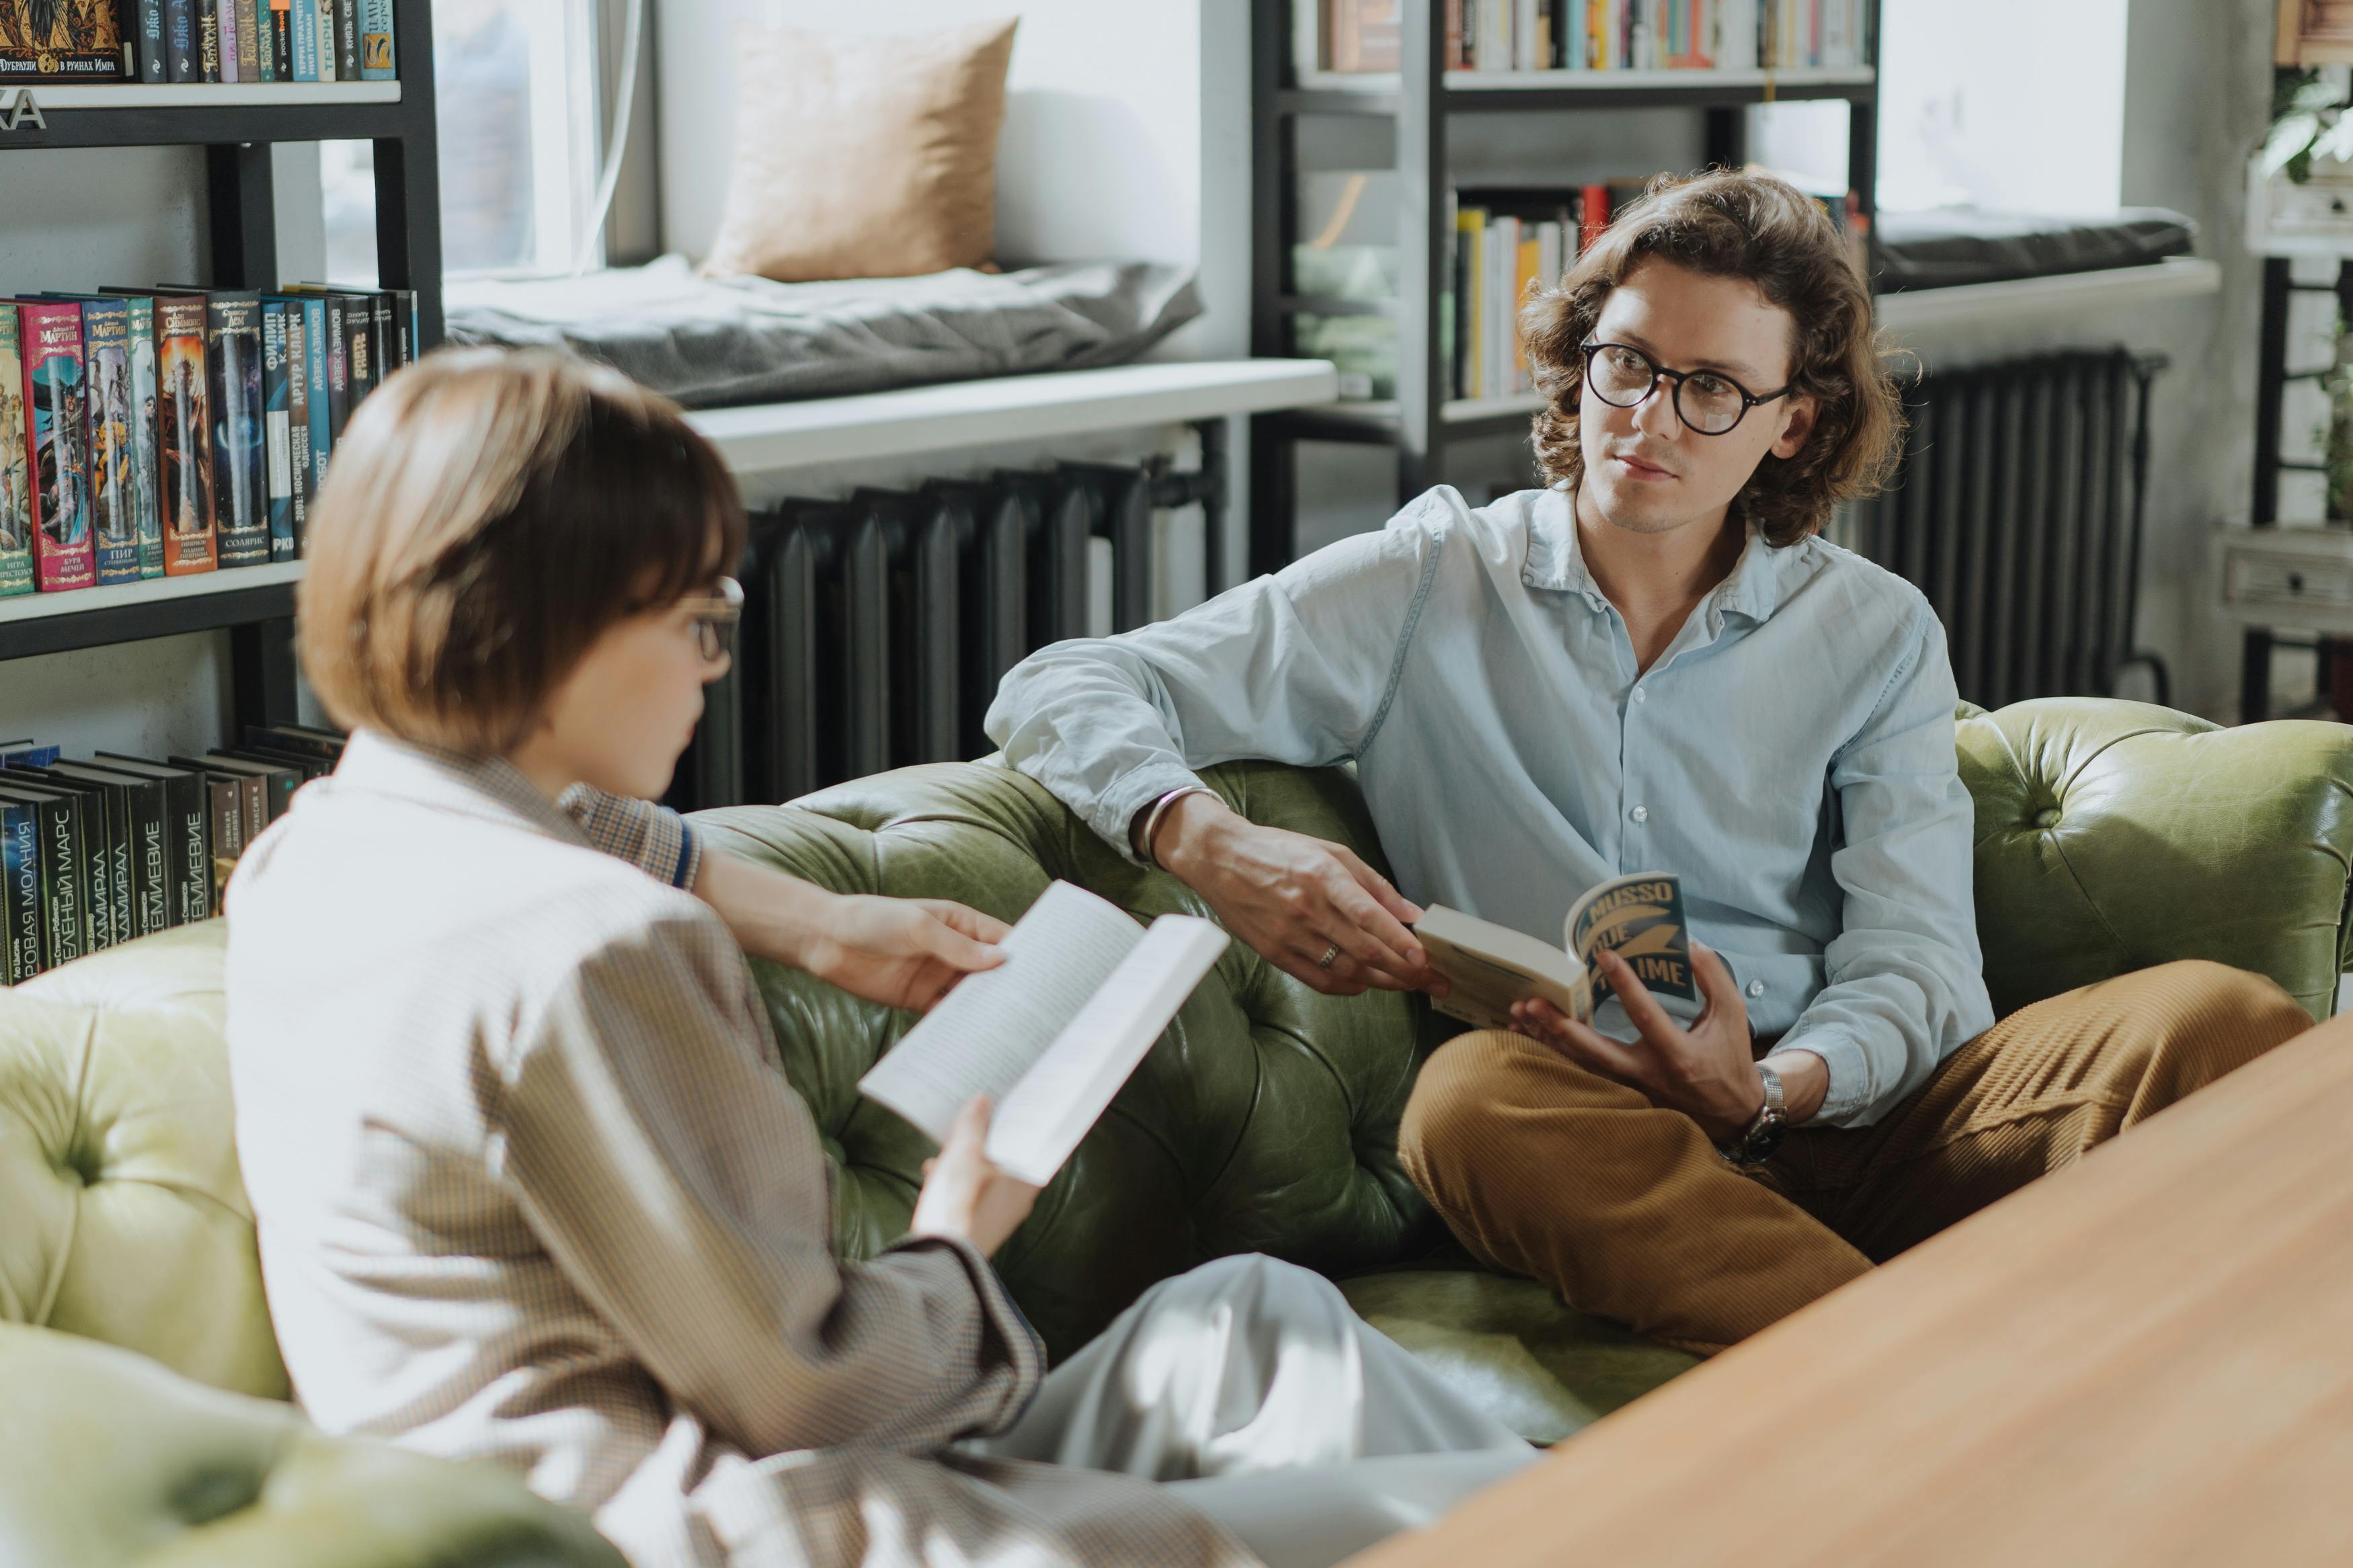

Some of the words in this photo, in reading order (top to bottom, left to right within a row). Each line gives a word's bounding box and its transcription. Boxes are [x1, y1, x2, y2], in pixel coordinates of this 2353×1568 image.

[306, 13, 315, 53] ГЕЙМАН
[323, 19, 333, 71] ТЕРРИ
[346, 21, 354, 49] КНЯЗЬ
[298, 48, 306, 75] ТЕРРИ
[307, 56, 315, 75] НИЛ
[264, 313, 278, 371] ФИЛИП
[278, 313, 286, 345] ДИК
[289, 313, 303, 359] КЛАРК
[311, 308, 322, 355] АЗИМОВ
[332, 308, 342, 355] АЗИМОВ
[292, 364, 305, 406] АРТУР
[312, 356, 323, 390] АЙЗЕК
[333, 356, 344, 391] АЙЗЕК
[291, 426, 303, 494] КОСМИЧЕСКАЯ
[301, 425, 309, 468] ОДИССЕЯ
[296, 495, 305, 522] 2001:
[64, 557, 81, 567] БУРЯ
[110, 548, 132, 560] ПИР
[225, 536, 265, 548] СОЛЯРИС
[7, 561, 25, 569] ИГРА
[61, 563, 85, 573] МЕЧЕЙ
[55, 809, 72, 872] МАРС
[19, 821, 34, 906] МОЛНИЯ
[146, 821, 164, 934] ЕМИЕВИЕ
[188, 812, 204, 923] ЕМИЕВИЕ
[57, 874, 77, 964] ЕЛЕНЫЙ
[1589, 882, 1673, 924] MUSSO
[23, 911, 37, 979] РОВАЯ
